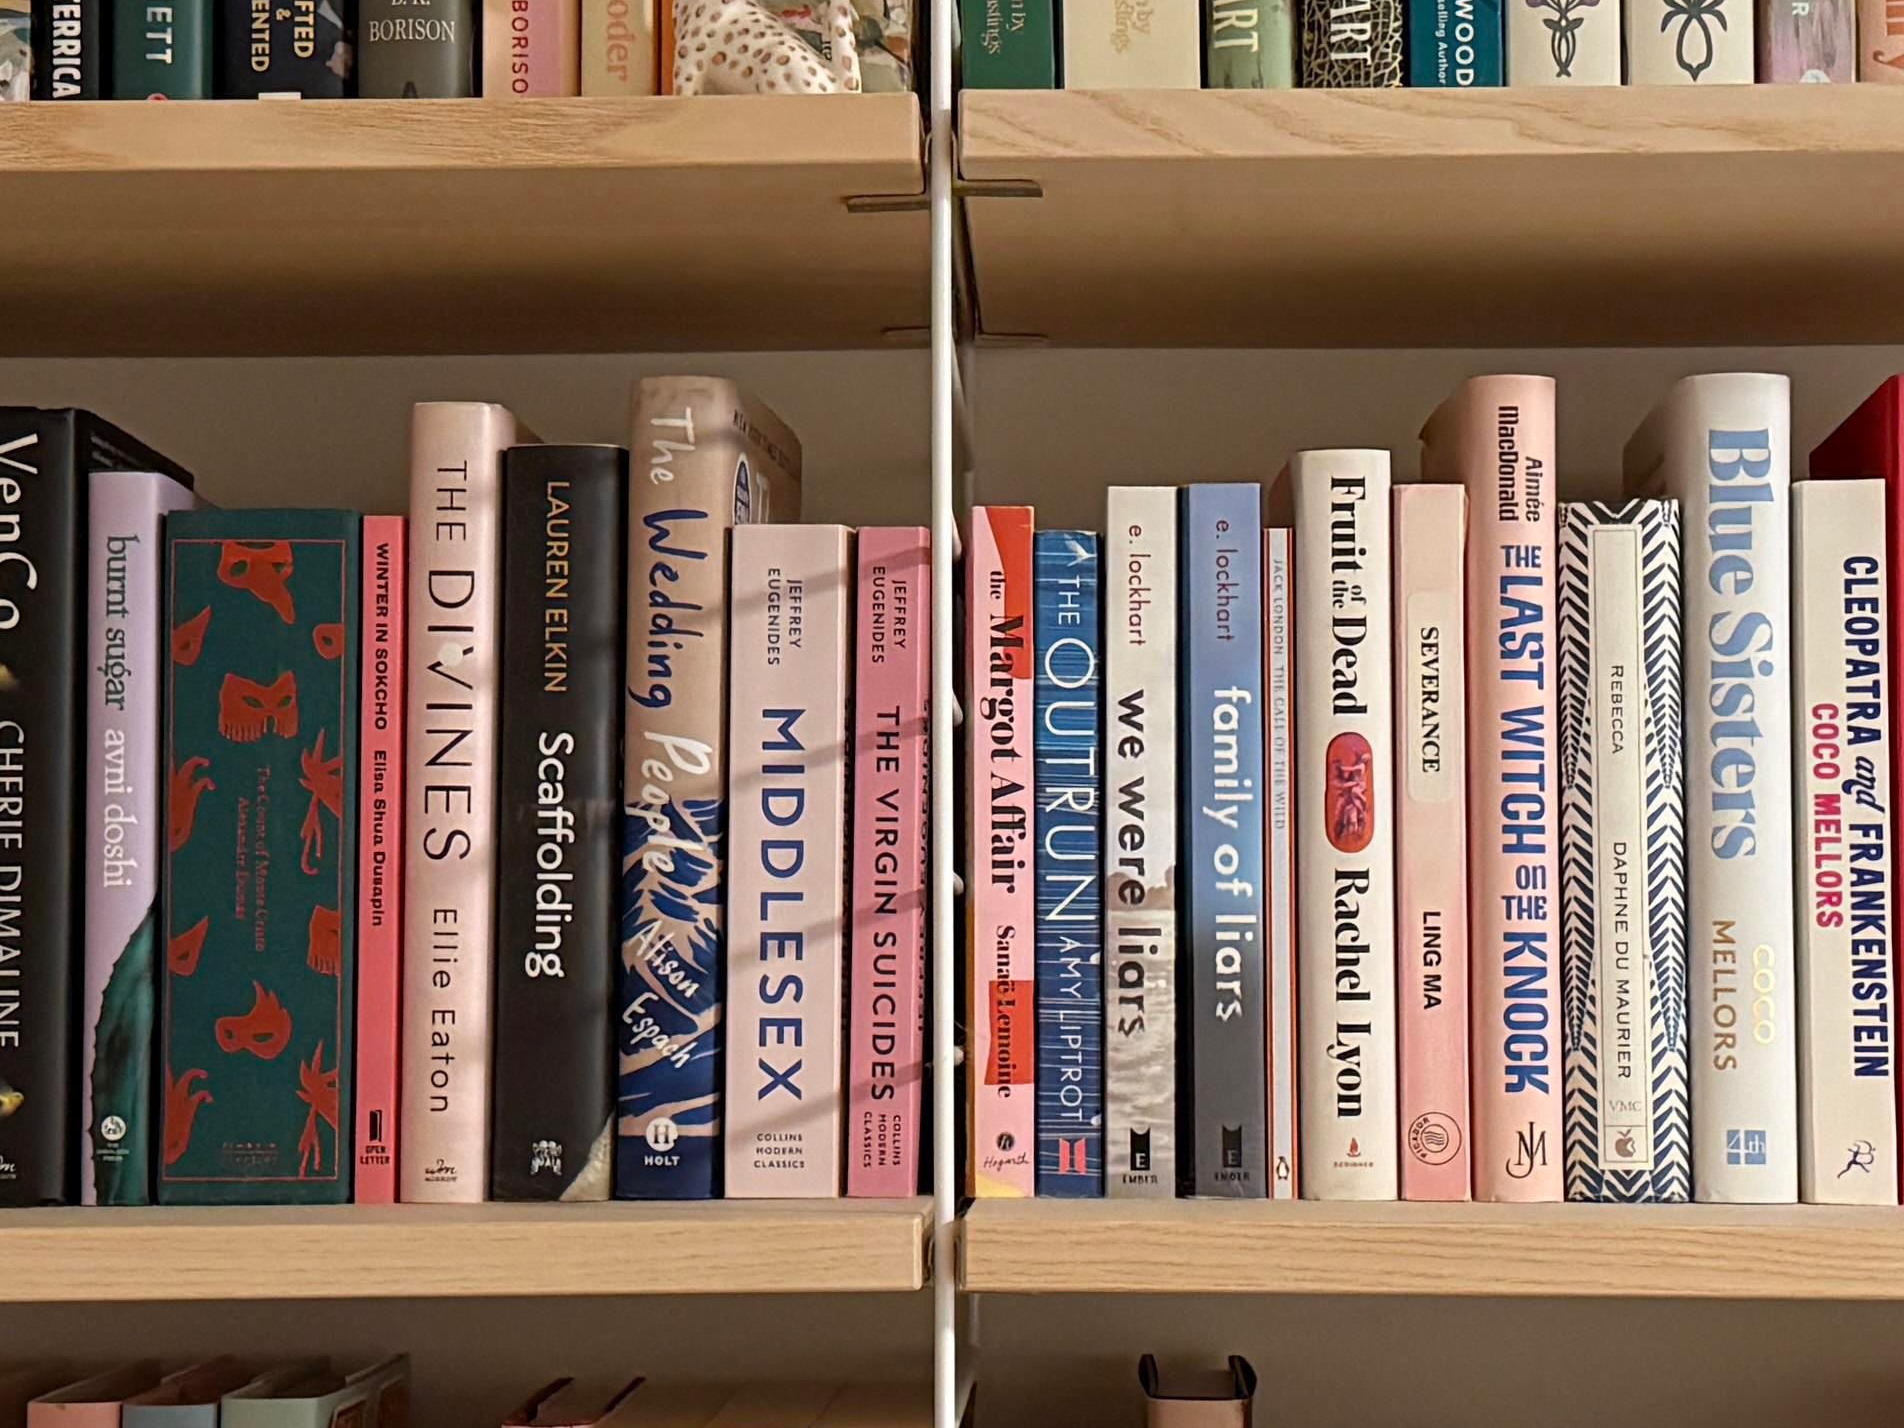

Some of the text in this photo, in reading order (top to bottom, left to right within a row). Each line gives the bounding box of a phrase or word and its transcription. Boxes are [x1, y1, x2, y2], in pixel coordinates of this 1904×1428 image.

[373, 542, 391, 732] WINTER IN SOKCHO
[1418, 626, 1441, 774] SEVERANCE
[1706, 427, 1776, 863] Blue Sisters
[1040, 636, 1096, 923] OUTRUN
[522, 731, 576, 979] Scaffolding
[756, 707, 808, 1104] MIDDLESEX
[1330, 867, 1374, 1120] Rachel Lyon
[1420, 910, 1441, 1010] LING MA
[1710, 919, 1738, 1072] MELLORS
[1750, 943, 1778, 1048] COCO
[643, 1155, 680, 1166] HOLT
[753, 1159, 806, 1171] CLASSICS
[756, 1132, 805, 1144] COLLINS
[756, 1145, 805, 1157] MODERN
